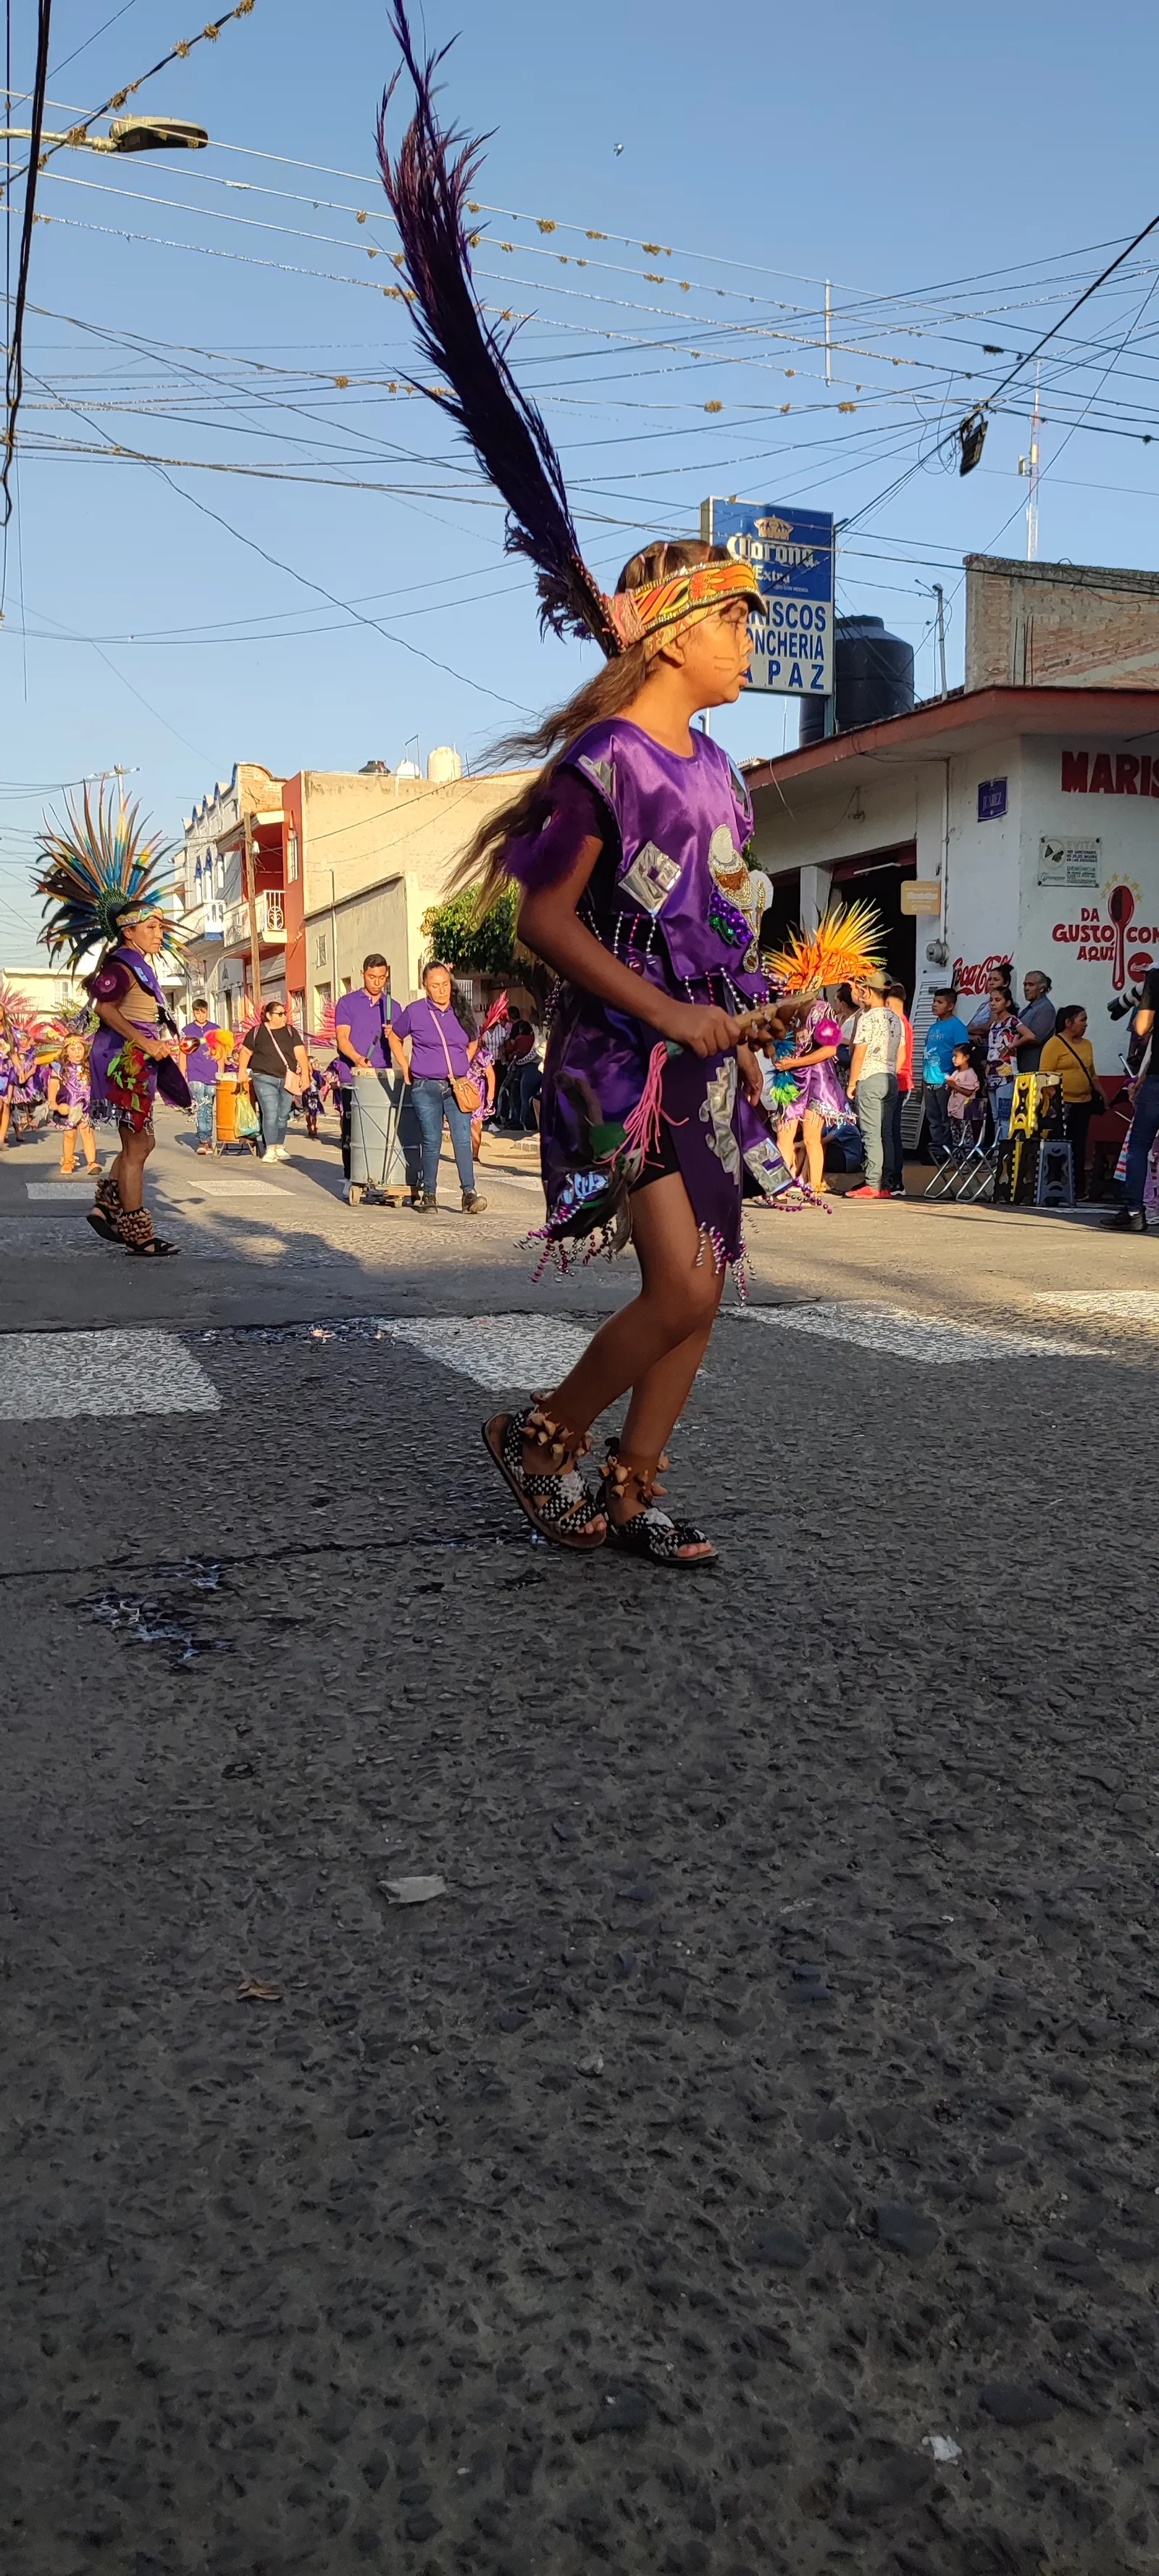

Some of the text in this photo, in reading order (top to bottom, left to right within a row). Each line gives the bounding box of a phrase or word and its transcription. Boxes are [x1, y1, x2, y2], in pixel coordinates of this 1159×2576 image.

[727, 532, 819, 568] Corona
[754, 564, 790, 584] Extra
[746, 627, 825, 661] NCHERIA
[768, 659, 824, 690] PAZ
[1081, 908, 1100, 922] DA
[1052, 924, 1115, 942] GUSTO
[1076, 941, 1115, 963] AQUÍ
